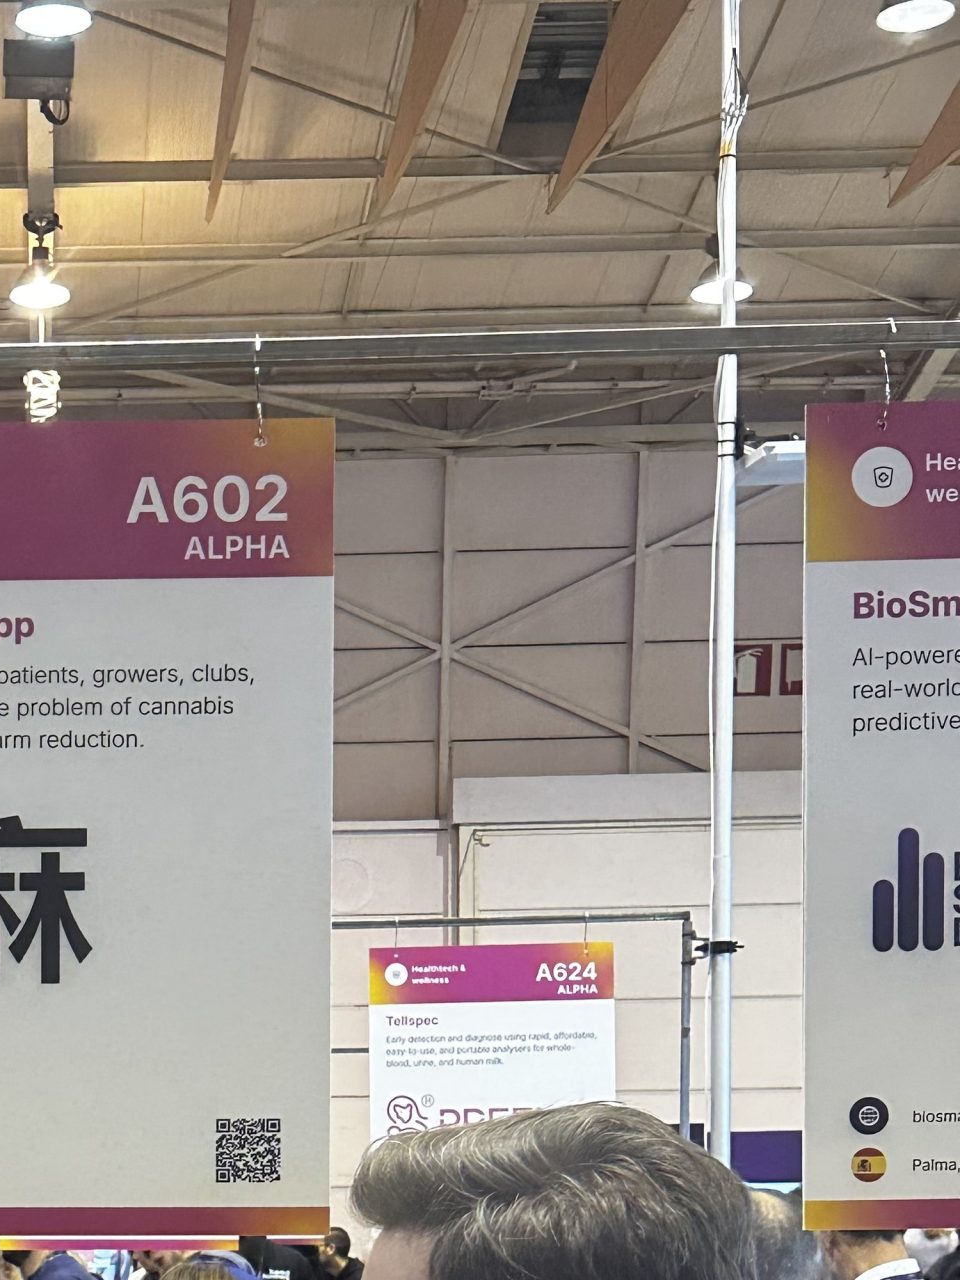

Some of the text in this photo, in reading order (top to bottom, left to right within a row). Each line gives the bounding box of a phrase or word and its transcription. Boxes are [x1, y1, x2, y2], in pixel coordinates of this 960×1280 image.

[925, 453, 960, 471] He
[126, 474, 289, 524] A602
[184, 534, 290, 560] ALPHA
[92, 665, 184, 688] growers,
[191, 663, 255, 686] clubs,
[17, 697, 103, 721] problem
[110, 696, 133, 716] of
[138, 695, 235, 716] cannabis
[852, 712, 960, 737] predictive
[39, 730, 145, 750] reduction.
[535, 961, 598, 982] A624
[557, 984, 599, 995] ALPHA
